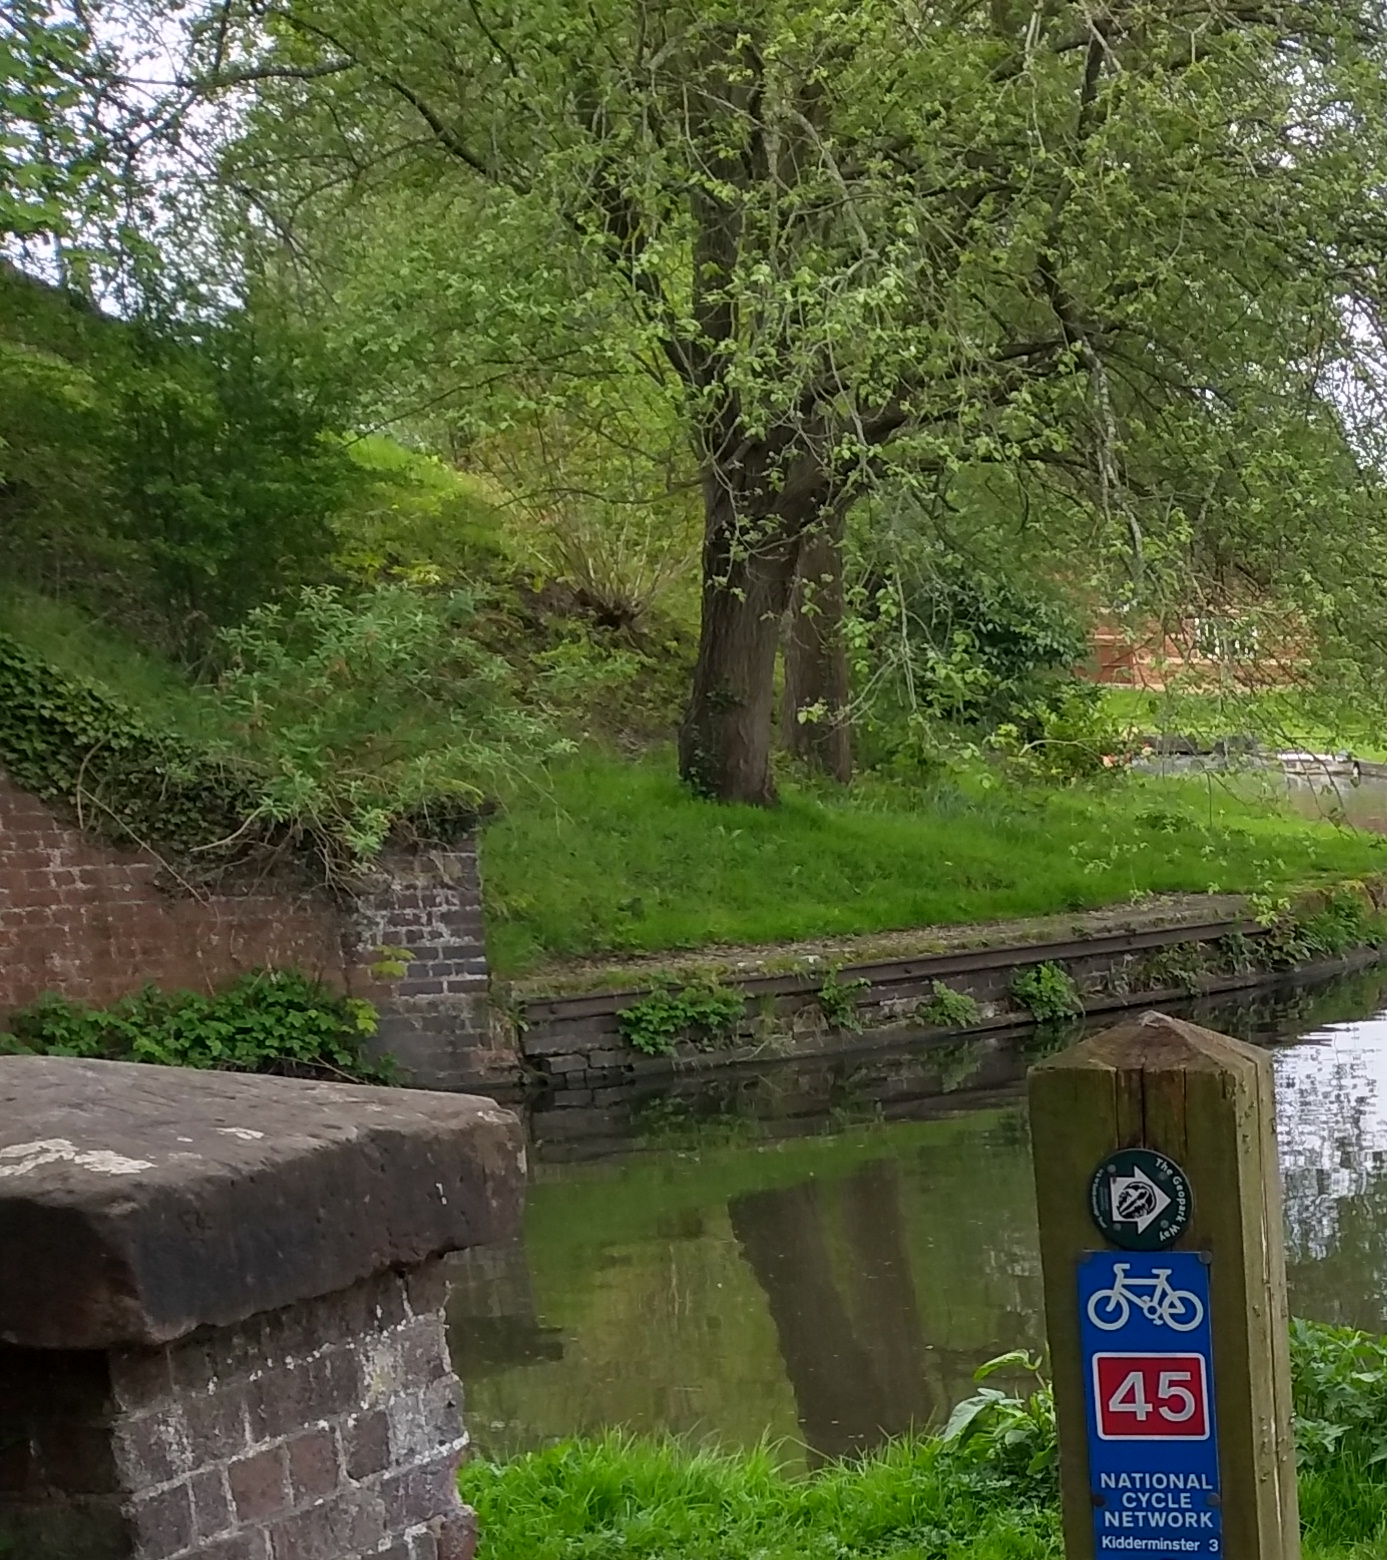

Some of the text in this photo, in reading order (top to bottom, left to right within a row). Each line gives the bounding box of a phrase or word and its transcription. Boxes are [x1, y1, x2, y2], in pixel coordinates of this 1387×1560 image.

[1155, 1157, 1187, 1242] The Geopark Way
[1108, 1370, 1197, 1422] 45
[1100, 1473, 1213, 1489] NATIONAL
[1122, 1492, 1192, 1508] CYCLE
[1104, 1511, 1214, 1528] NETWORK
[1101, 1535, 1219, 1552] Kidderminster 3
